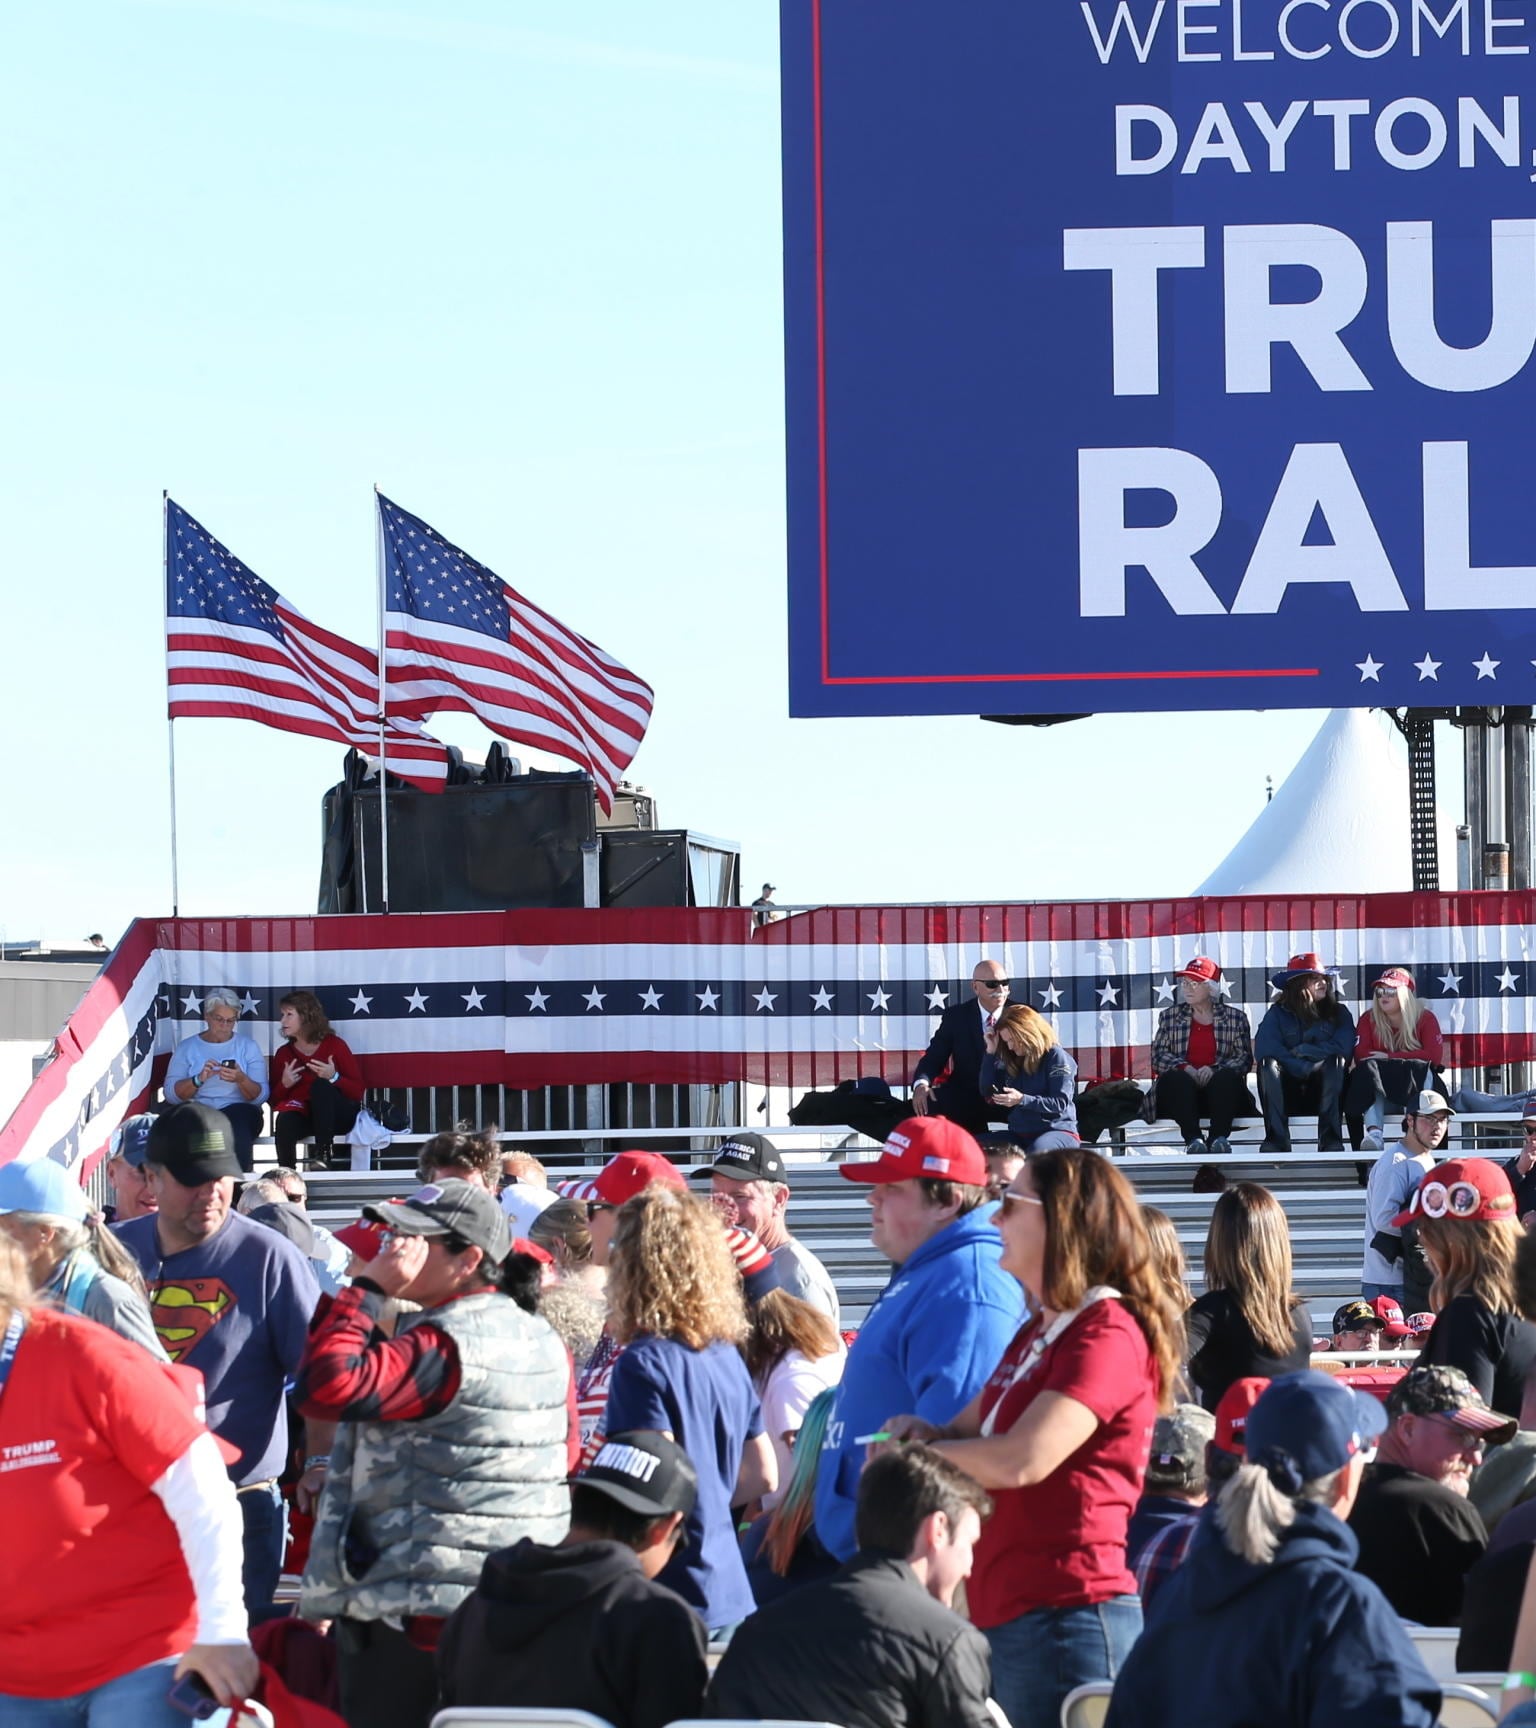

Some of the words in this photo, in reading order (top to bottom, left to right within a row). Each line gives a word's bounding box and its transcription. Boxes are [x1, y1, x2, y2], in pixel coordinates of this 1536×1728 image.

[1080, 0, 1531, 64] WELCOME
[724, 1142, 756, 1155] AMERICA
[726, 1150, 751, 1161] AGAIN
[2, 1439, 57, 1460] TRUMP
[592, 1442, 662, 1483] PATRIOT
